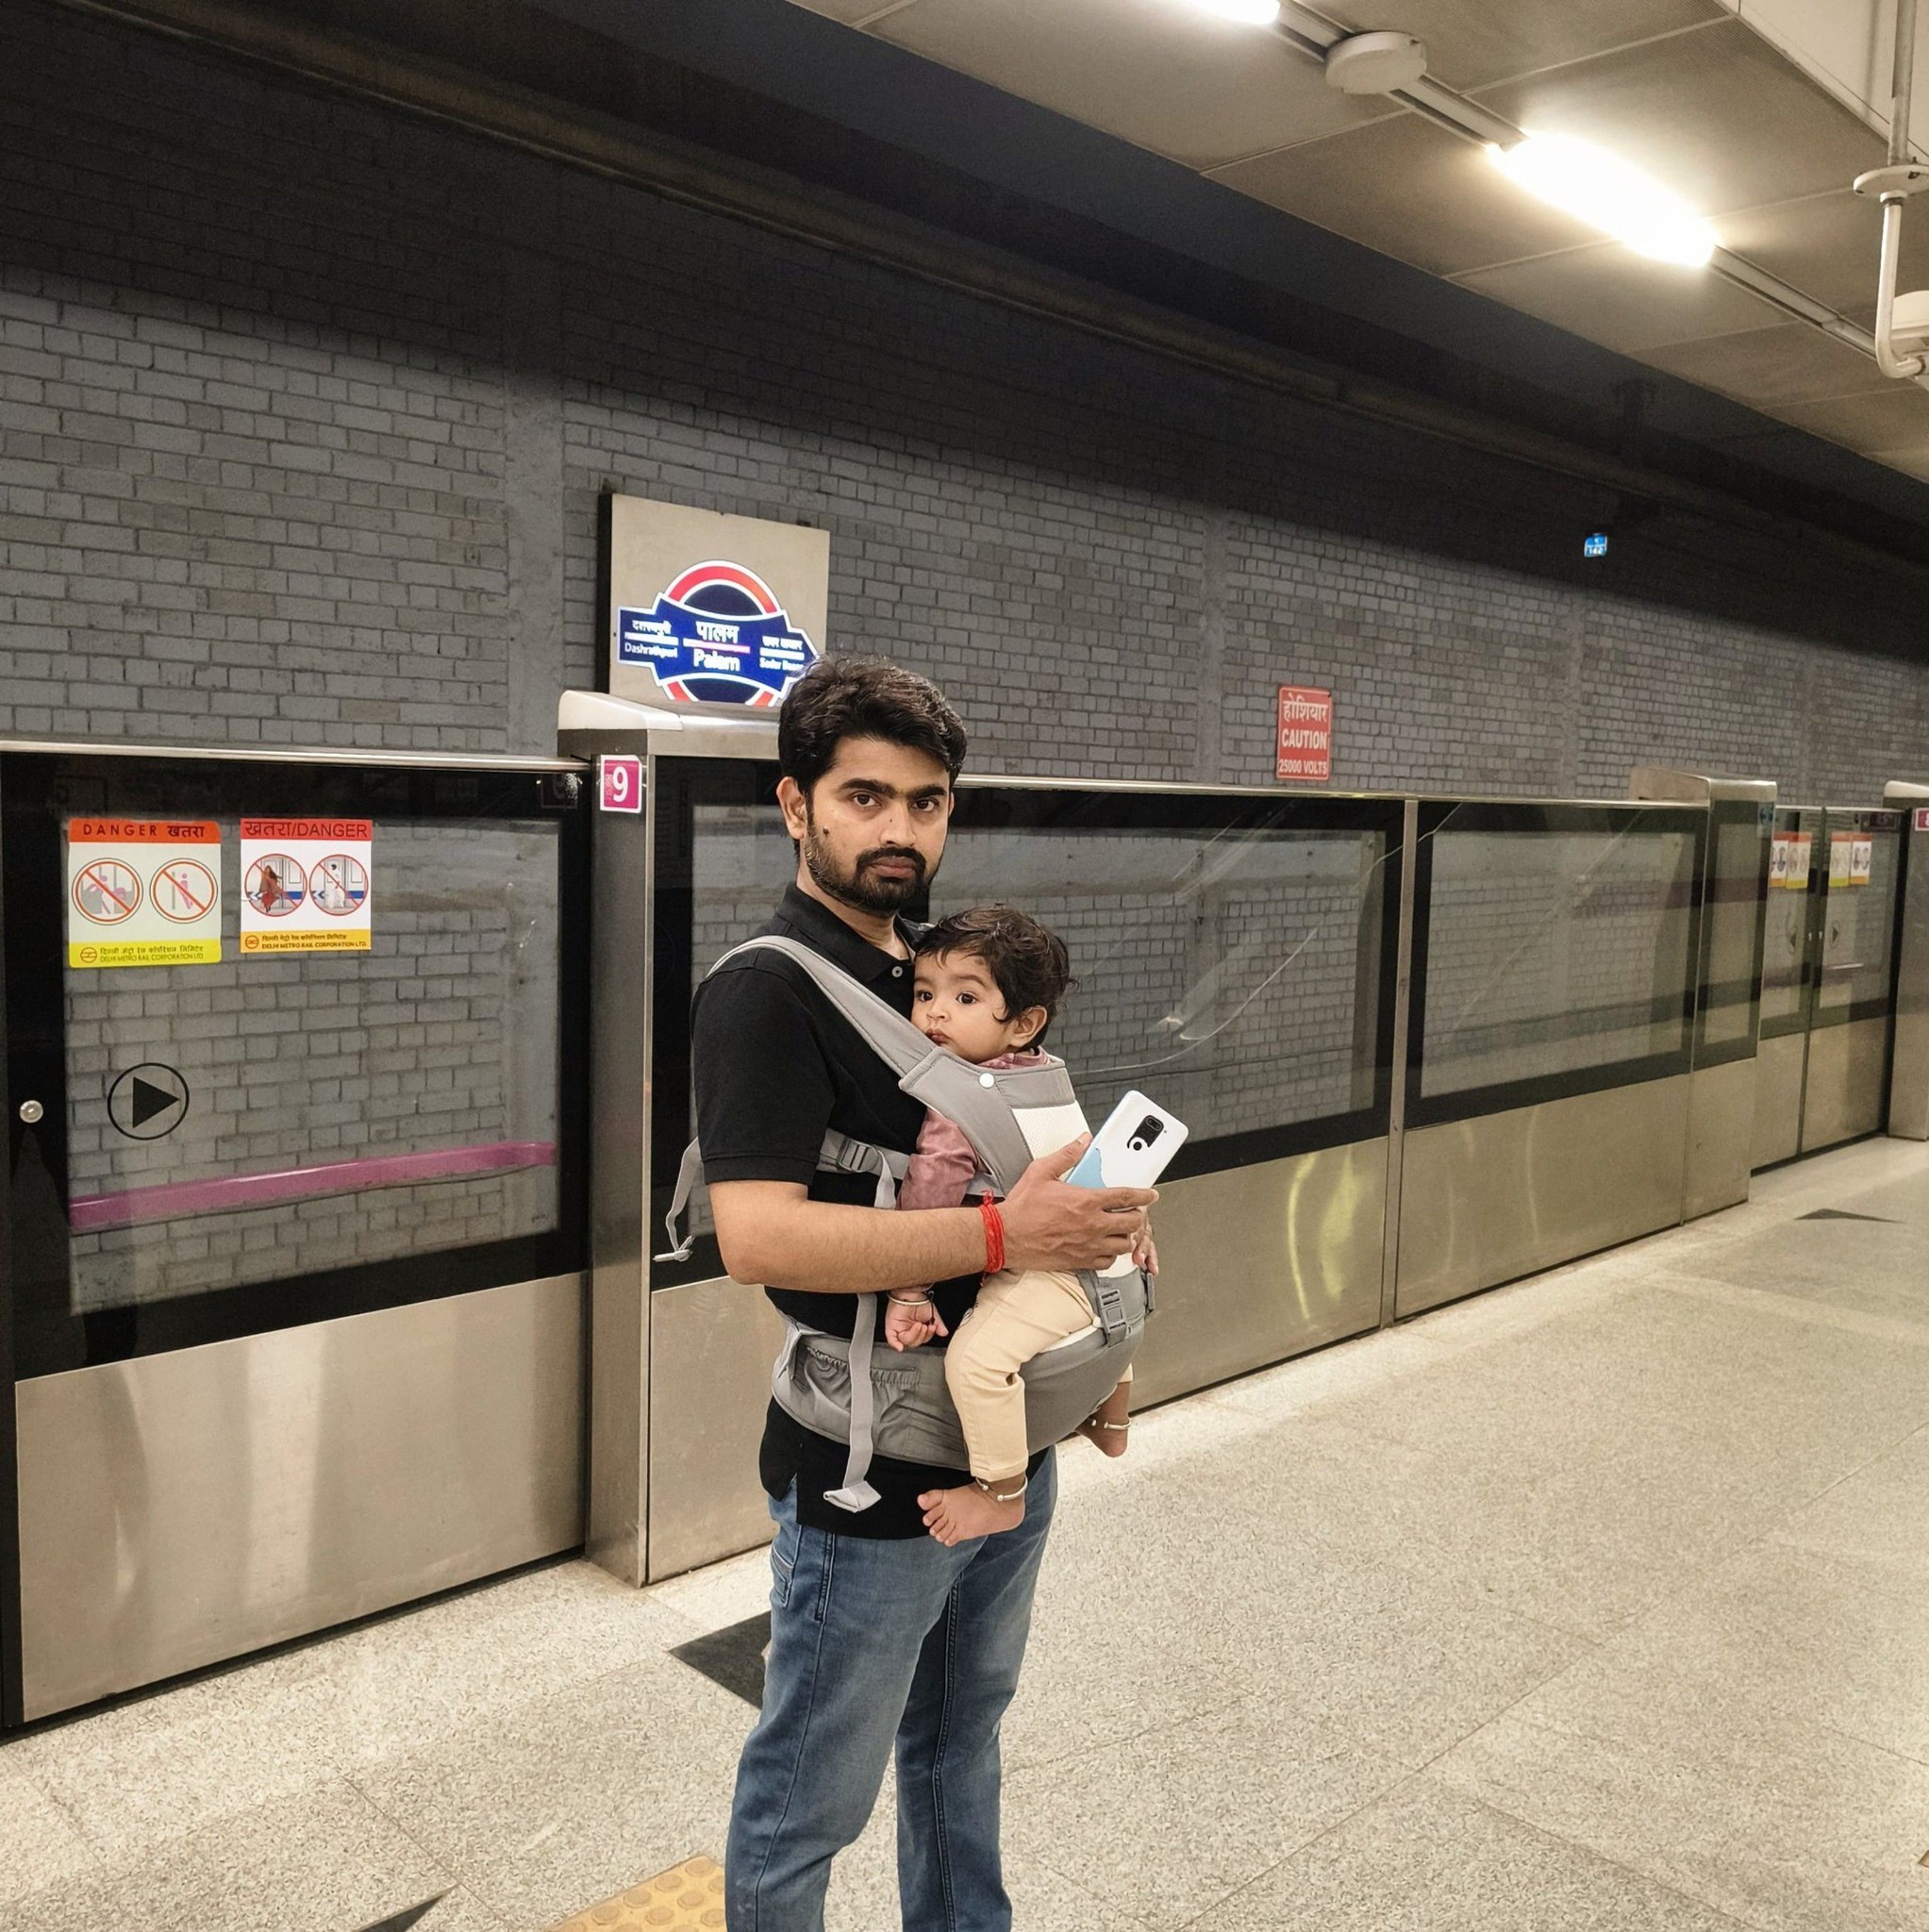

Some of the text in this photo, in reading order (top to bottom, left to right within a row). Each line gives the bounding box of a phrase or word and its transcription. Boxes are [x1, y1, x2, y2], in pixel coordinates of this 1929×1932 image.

[695, 621, 740, 643] पालम
[693, 649, 740, 672] Palam
[1283, 692, 1328, 723] होशियार
[1282, 728, 1327, 750] CAUTION
[1278, 758, 1327, 774] 25000 VOLTS
[612, 765, 629, 803] 9
[83, 824, 205, 838] DANGER खतरा
